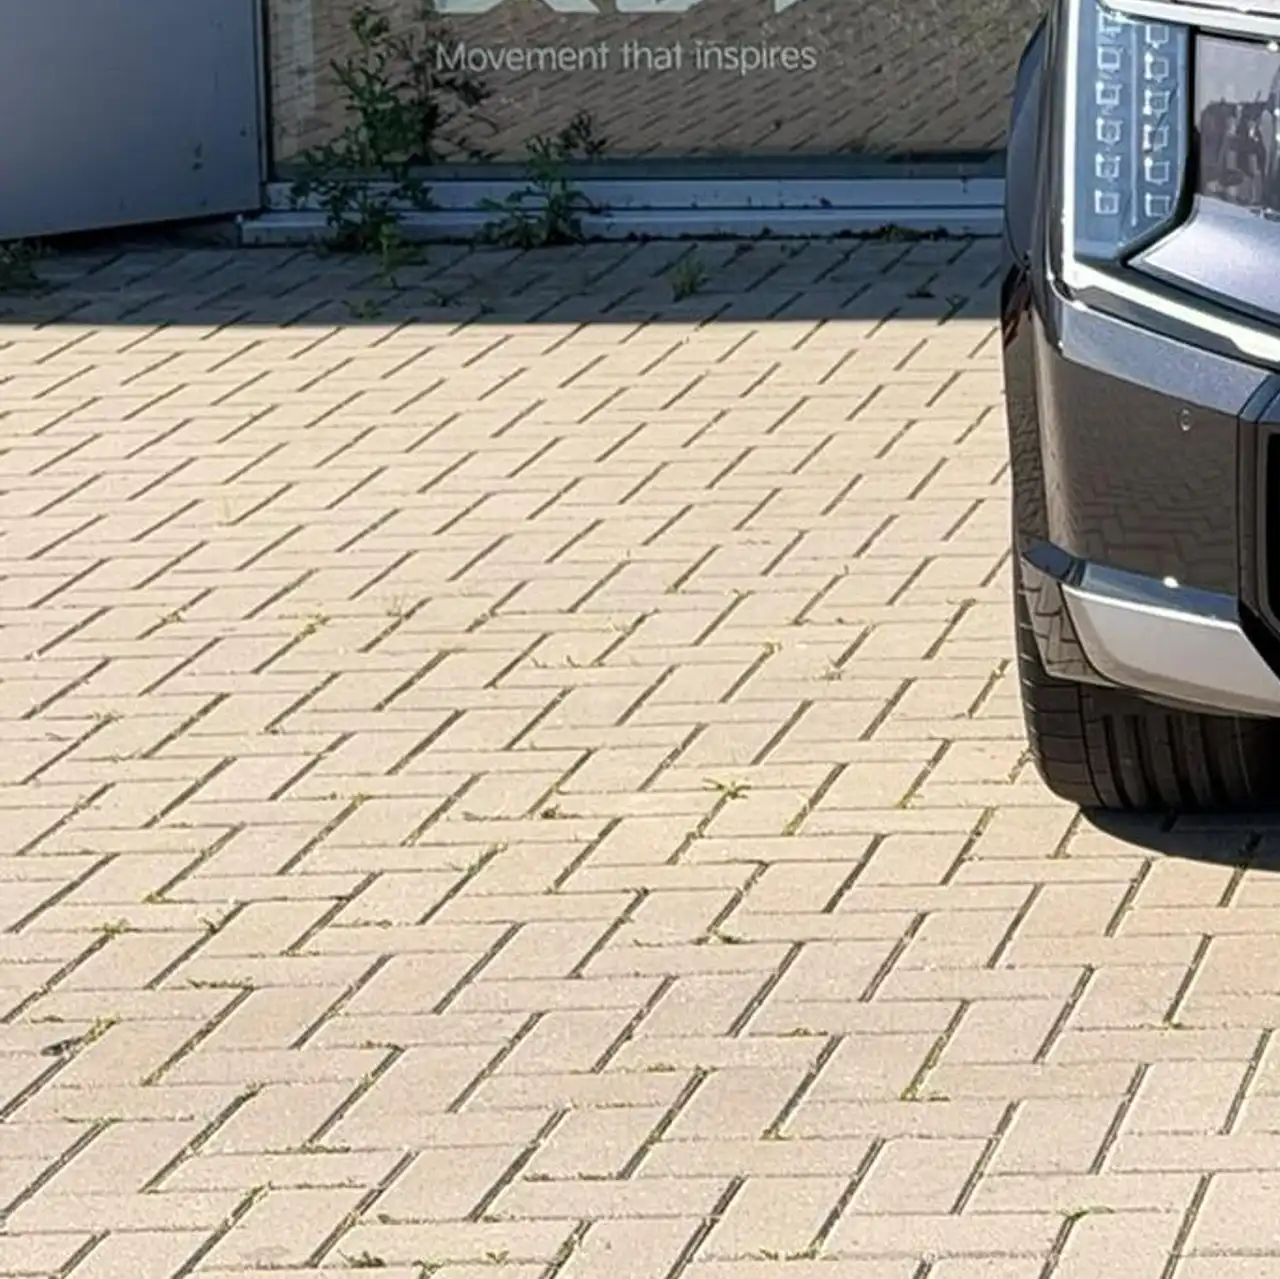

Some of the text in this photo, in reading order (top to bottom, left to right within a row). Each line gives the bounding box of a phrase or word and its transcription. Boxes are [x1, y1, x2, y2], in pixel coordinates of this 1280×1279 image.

[436, 40, 818, 76] Movement that inspires
